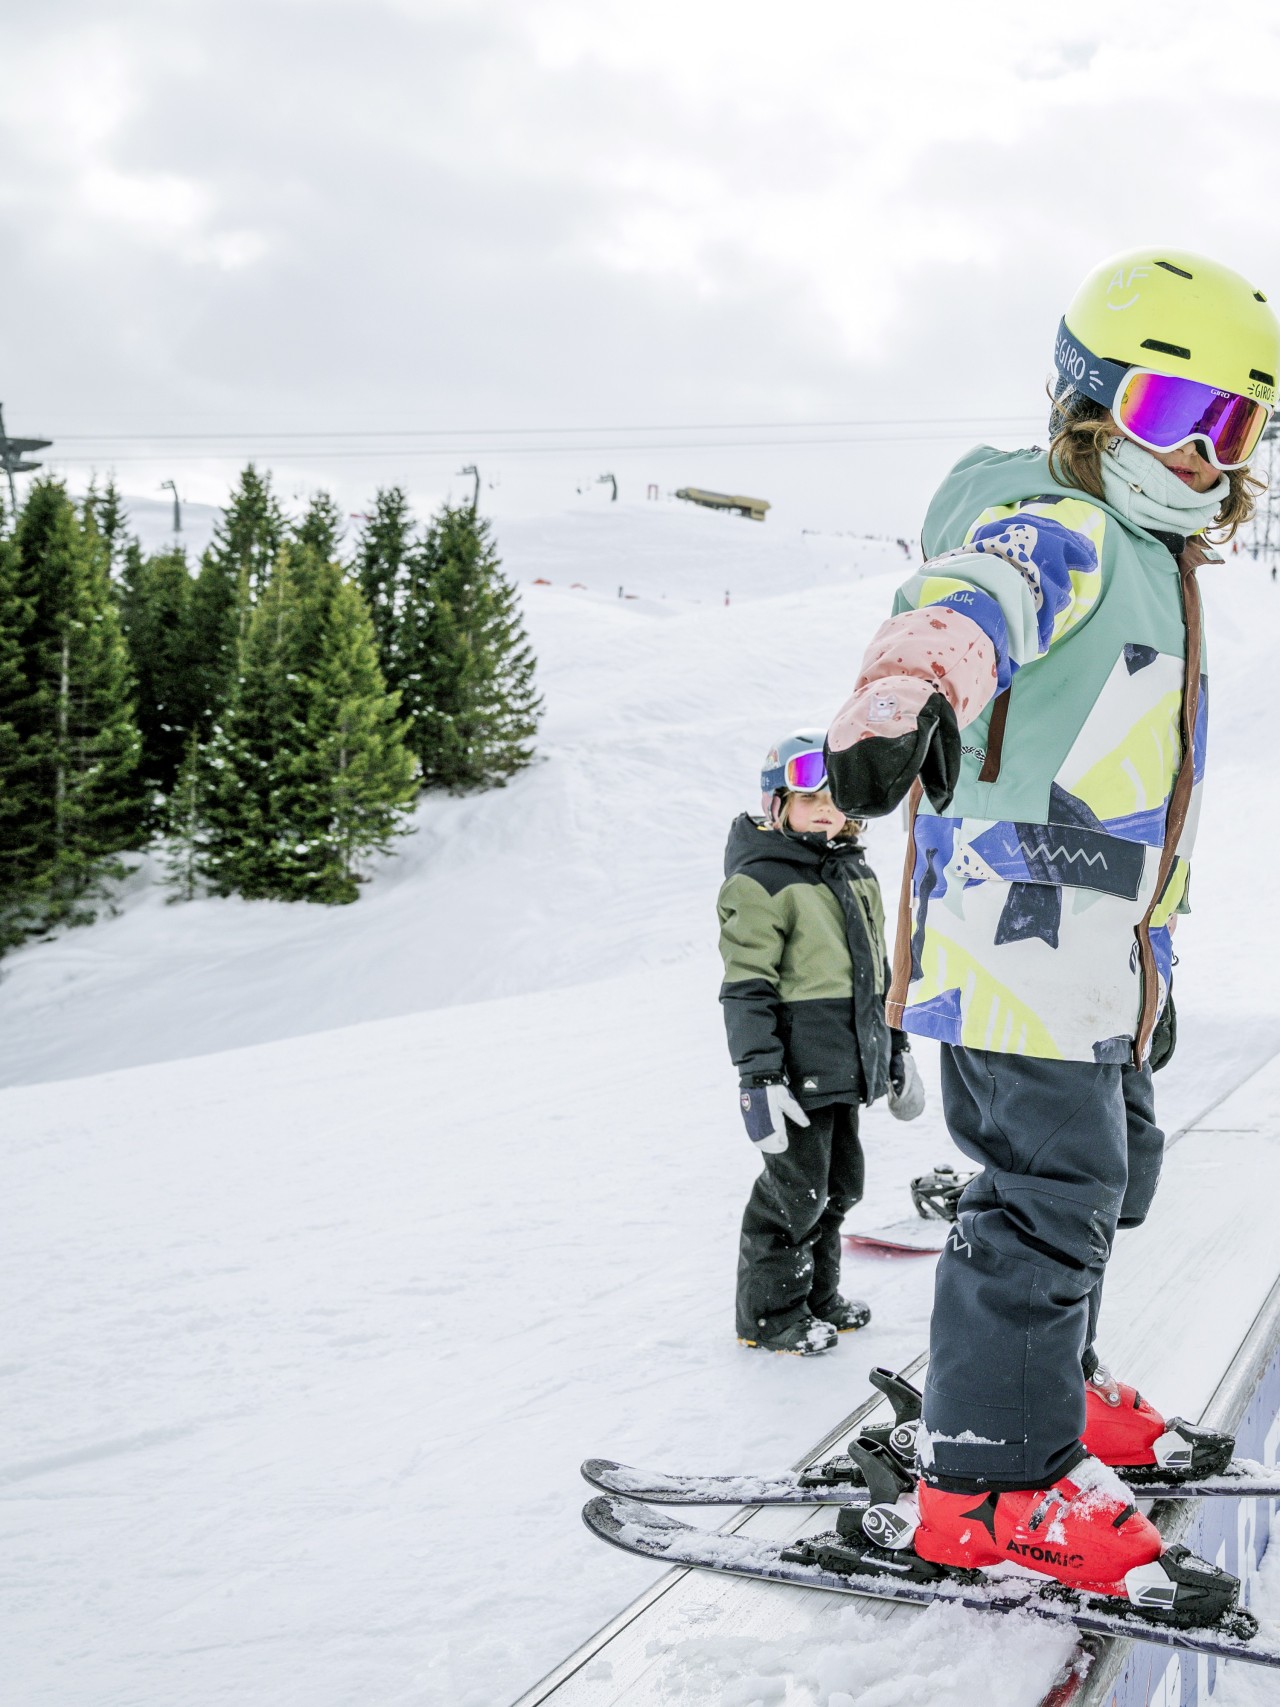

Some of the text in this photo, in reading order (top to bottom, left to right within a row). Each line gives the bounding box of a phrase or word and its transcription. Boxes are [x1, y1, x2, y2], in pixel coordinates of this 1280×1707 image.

[1106, 266, 1153, 292] AF
[1059, 338, 1086, 380] GIRO
[1210, 388, 1231, 399] GIRO
[1255, 383, 1272, 401] GIRO
[884, 1529, 894, 1542] 5
[1006, 1539, 1085, 1569] ATOMIC
